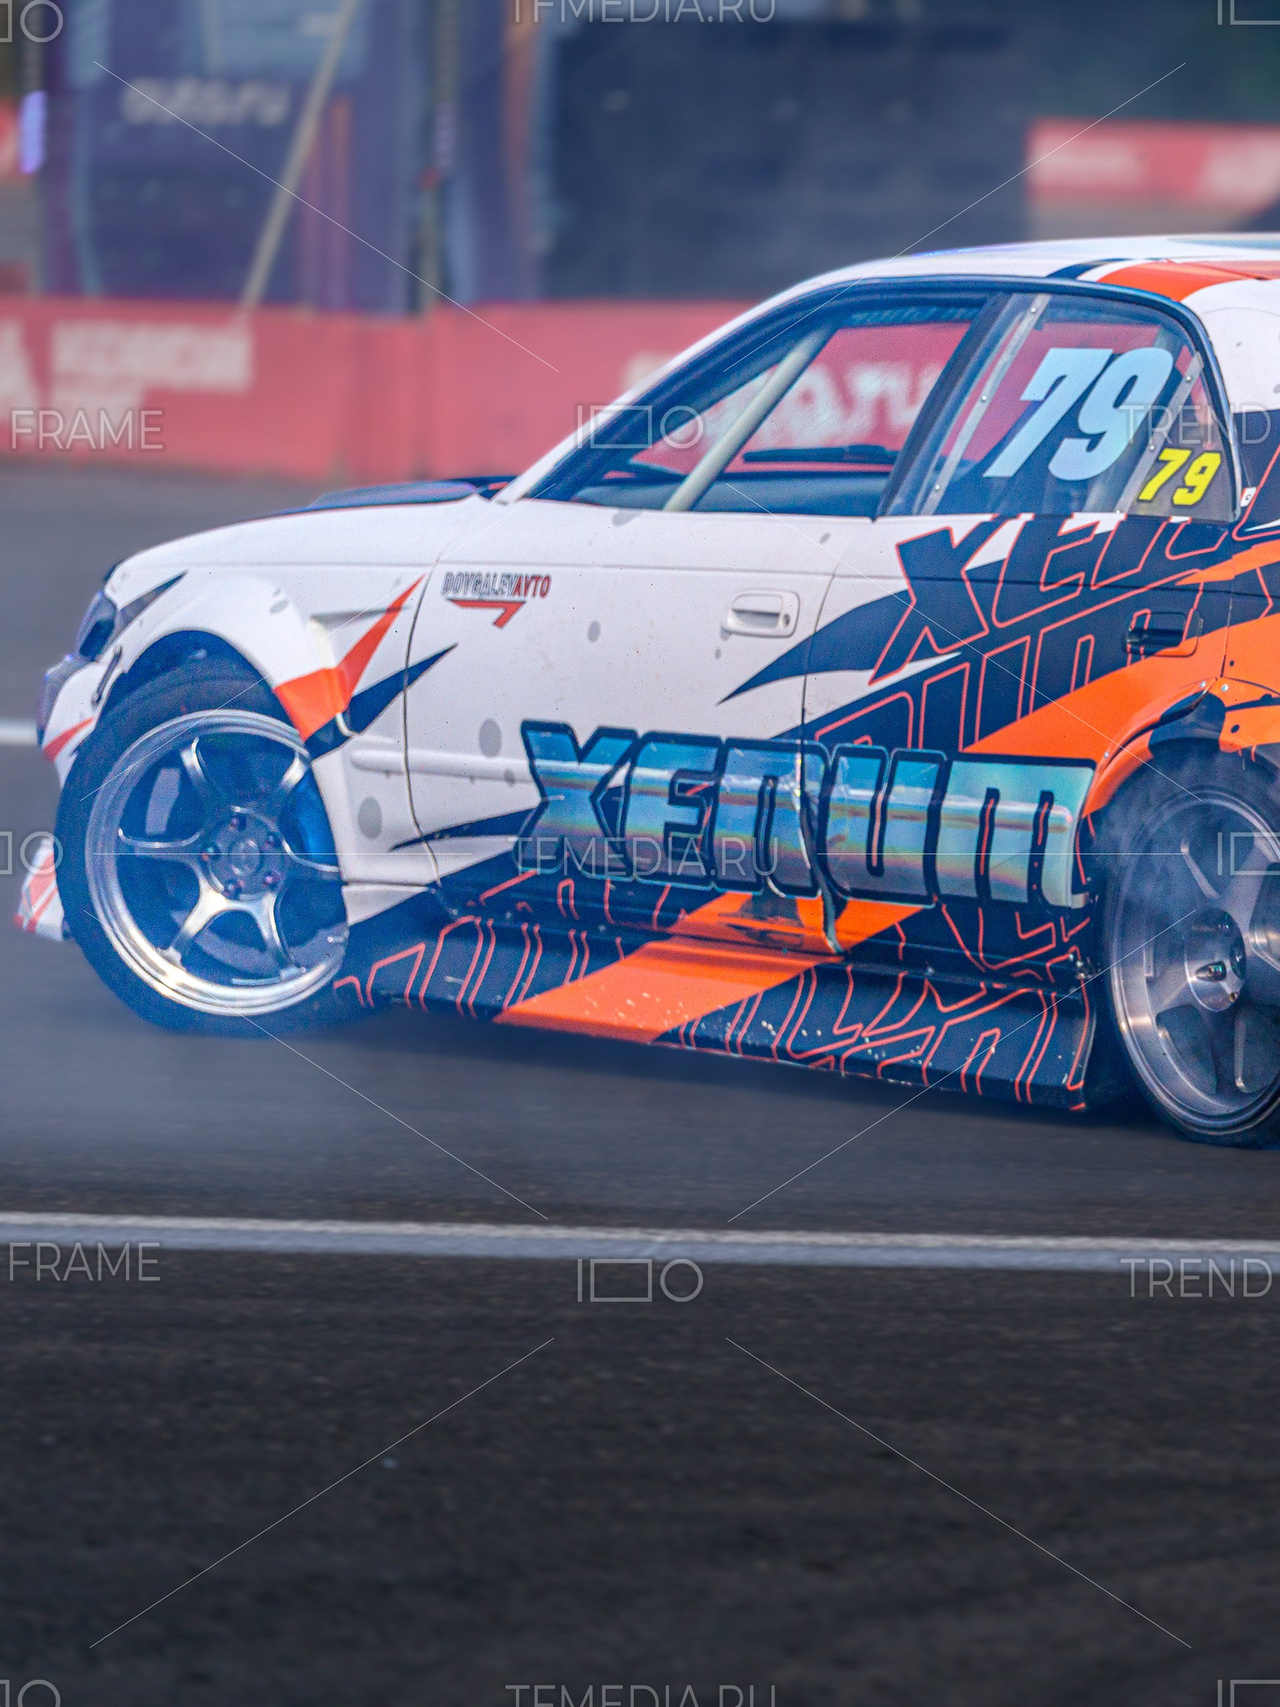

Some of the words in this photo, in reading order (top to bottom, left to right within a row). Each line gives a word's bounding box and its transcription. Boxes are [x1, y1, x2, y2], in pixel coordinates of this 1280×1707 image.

[983, 347, 1174, 481] 79
[1137, 447, 1221, 506] 79
[511, 719, 1098, 909] XENUM
